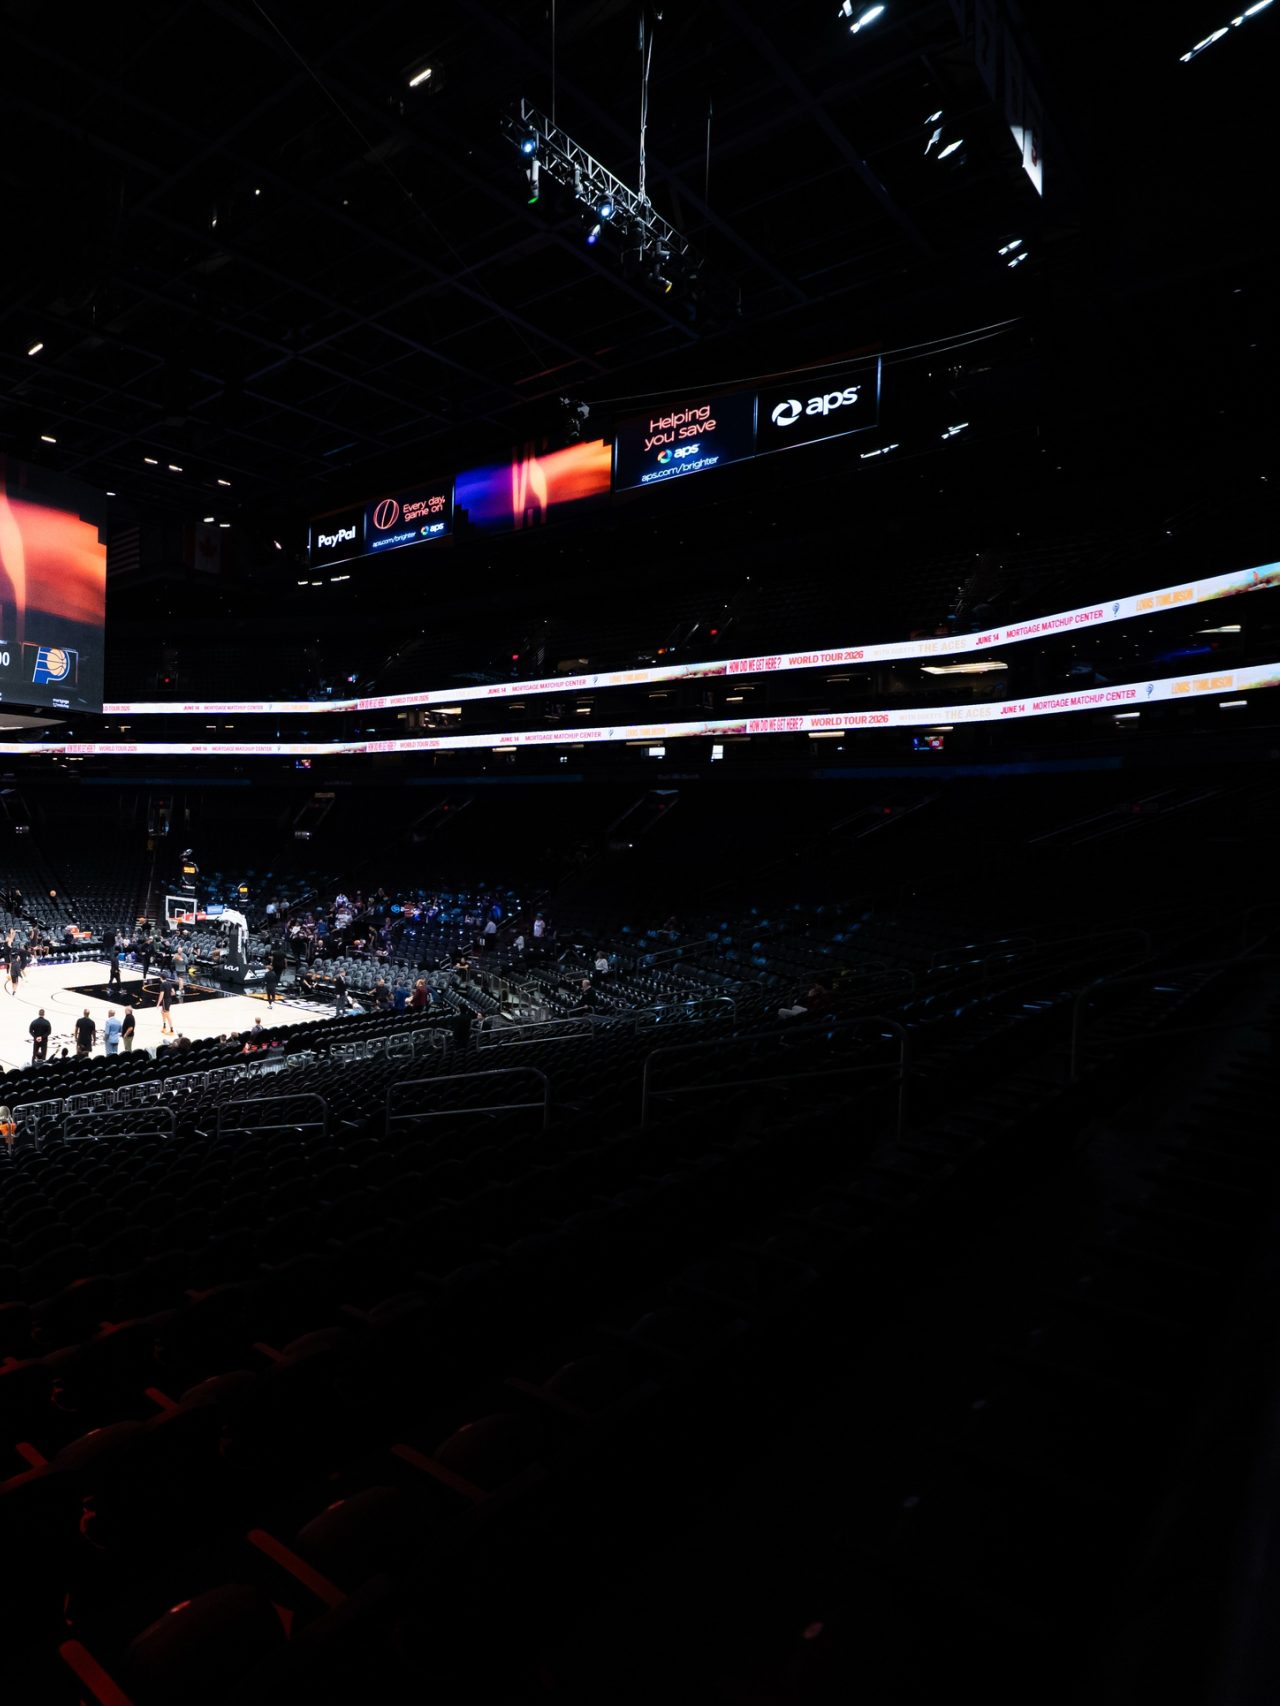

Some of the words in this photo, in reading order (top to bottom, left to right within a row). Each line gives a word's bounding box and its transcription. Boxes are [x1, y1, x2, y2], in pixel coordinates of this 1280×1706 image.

[806, 385, 861, 415] aps
[649, 405, 711, 433] Helping
[644, 432, 675, 451] you
[678, 418, 717, 439] save
[674, 443, 700, 458] aps
[641, 455, 719, 483] aps.com/brighter
[403, 501, 427, 513] Every
[428, 495, 445, 507] day,
[404, 507, 429, 522] game
[431, 504, 443, 513] on
[318, 526, 356, 548] PayPal
[372, 531, 416, 548] aps.com/brighter
[430, 522, 444, 533] aps
[729, 661, 739, 673] HOW
[748, 660, 755, 671] WE
[756, 659, 764, 671] GET
[765, 657, 782, 670] HERE?
[788, 655, 819, 665] WORLD
[820, 652, 843, 662] TOUR
[844, 650, 864, 660] 2026
[976, 634, 992, 645] JUNE
[993, 633, 999, 641] 14
[1006, 625, 1041, 639] MORTGAGE
[1042, 617, 1074, 632] MATCHUP
[1075, 610, 1104, 624] CENTER
[749, 720, 759, 732] HOW
[760, 719, 768, 731] DID
[770, 719, 776, 730] WE
[777, 718, 786, 730] GET
[786, 717, 804, 729] HERE?
[810, 717, 842, 727] WORLD
[843, 715, 867, 725] TOUR
[868, 714, 889, 723] 2026
[1000, 705, 1017, 715] JUNE
[1019, 704, 1025, 712] 14
[1032, 698, 1069, 711] MORTGAGE
[1070, 693, 1104, 706] MATCHUP
[1106, 689, 1137, 702] CENTER
